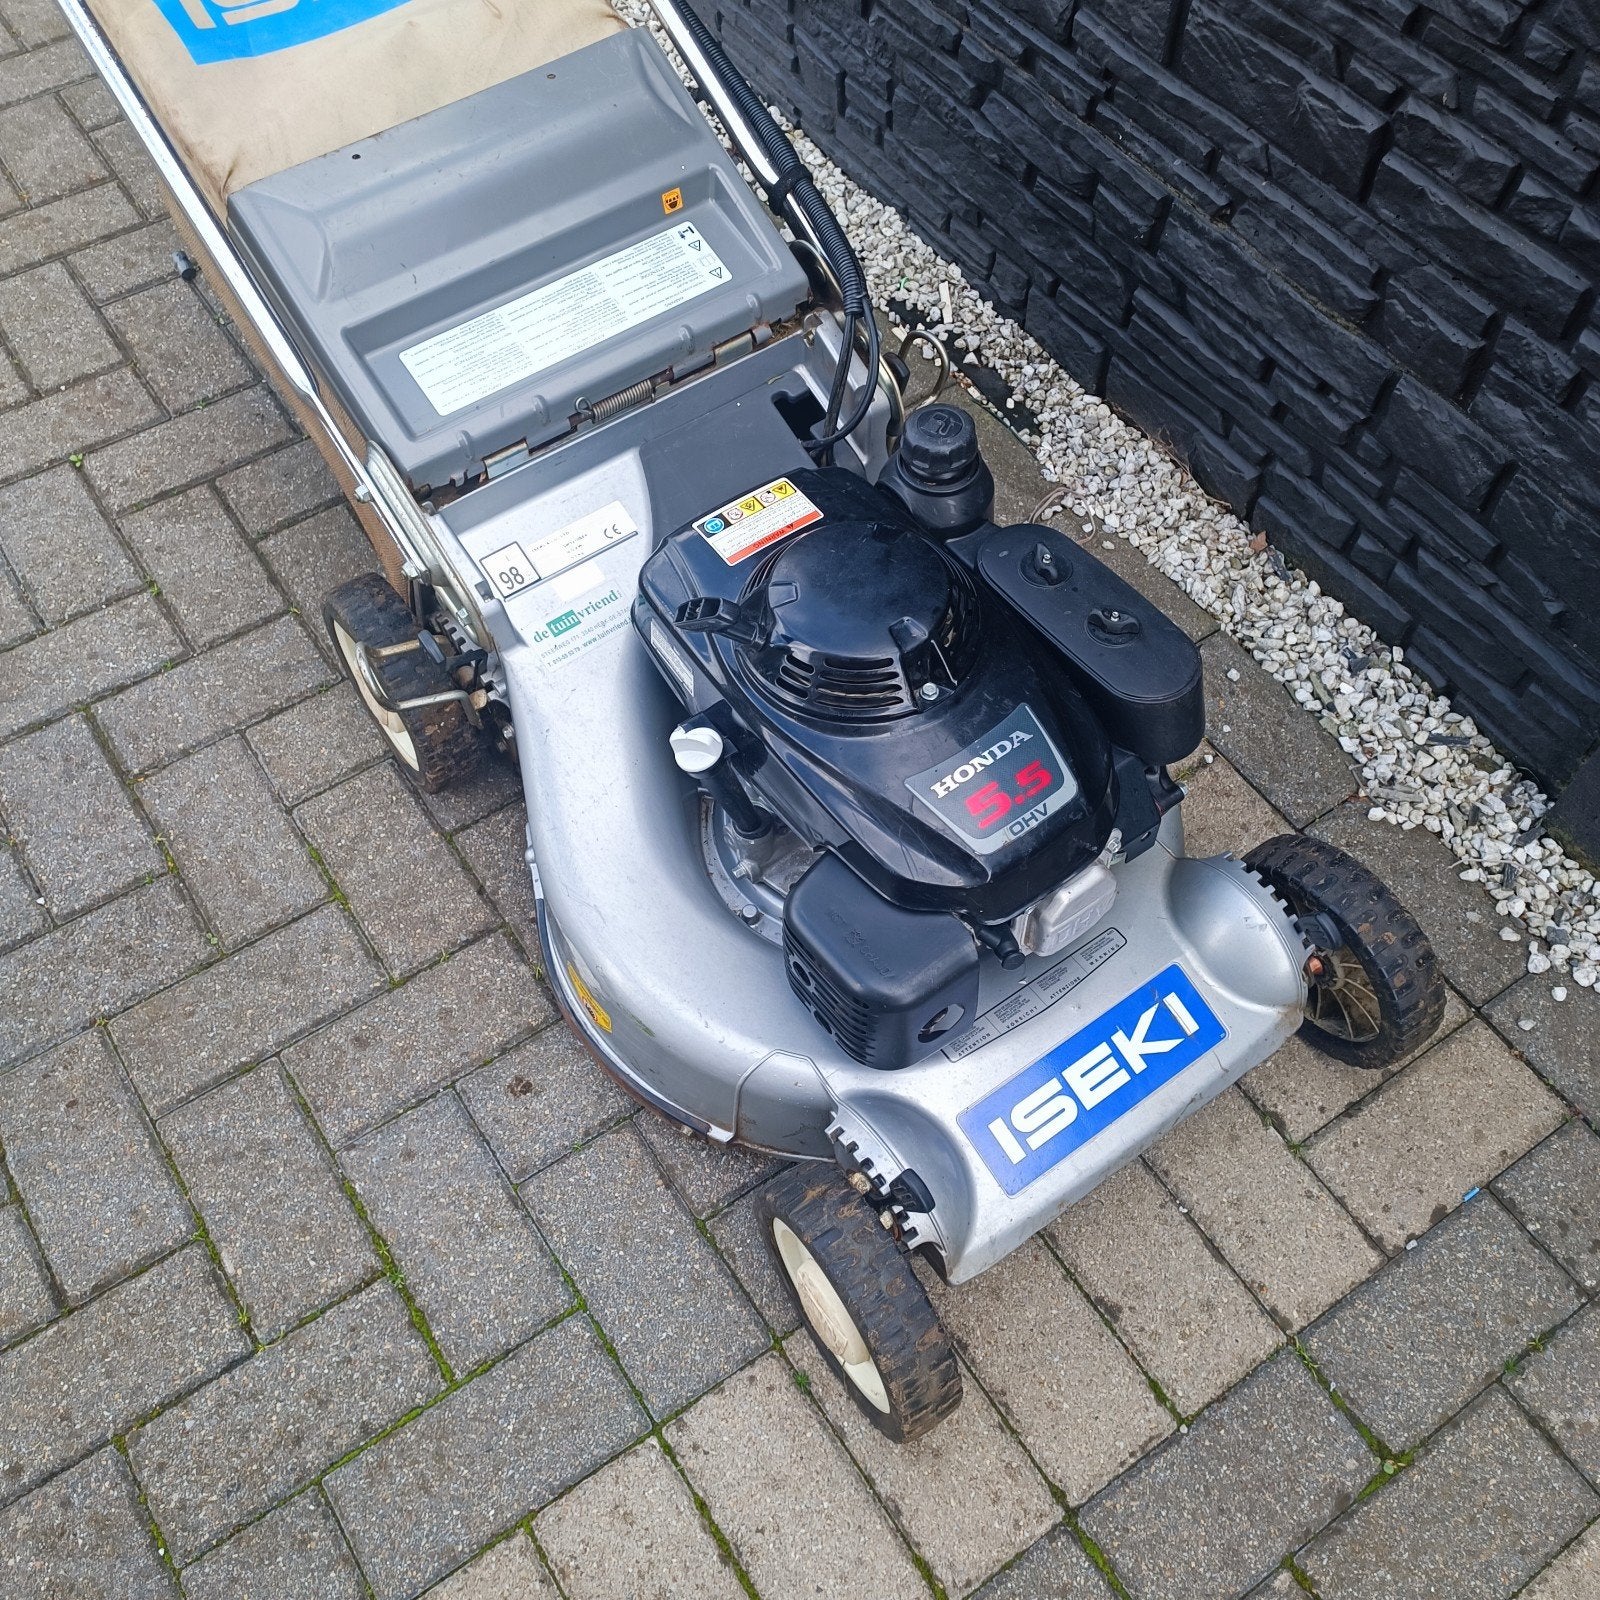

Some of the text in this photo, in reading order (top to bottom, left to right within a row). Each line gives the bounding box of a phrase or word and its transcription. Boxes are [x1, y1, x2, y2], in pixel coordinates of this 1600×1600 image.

[753, 529, 786, 548] WARNING
[499, 566, 525, 590] 98
[533, 590, 619, 643] de tuinvriend
[930, 730, 1033, 799] HONDA
[964, 759, 1053, 829] 5.5
[1009, 803, 1049, 837] OHV
[1089, 943, 1121, 966] WARNING
[1049, 976, 1081, 1000] ATTENZIONE
[1006, 1005, 1039, 1030] VORSICHT
[958, 1032, 992, 1058] ATTENTION
[987, 992, 1200, 1165] ISEKI
